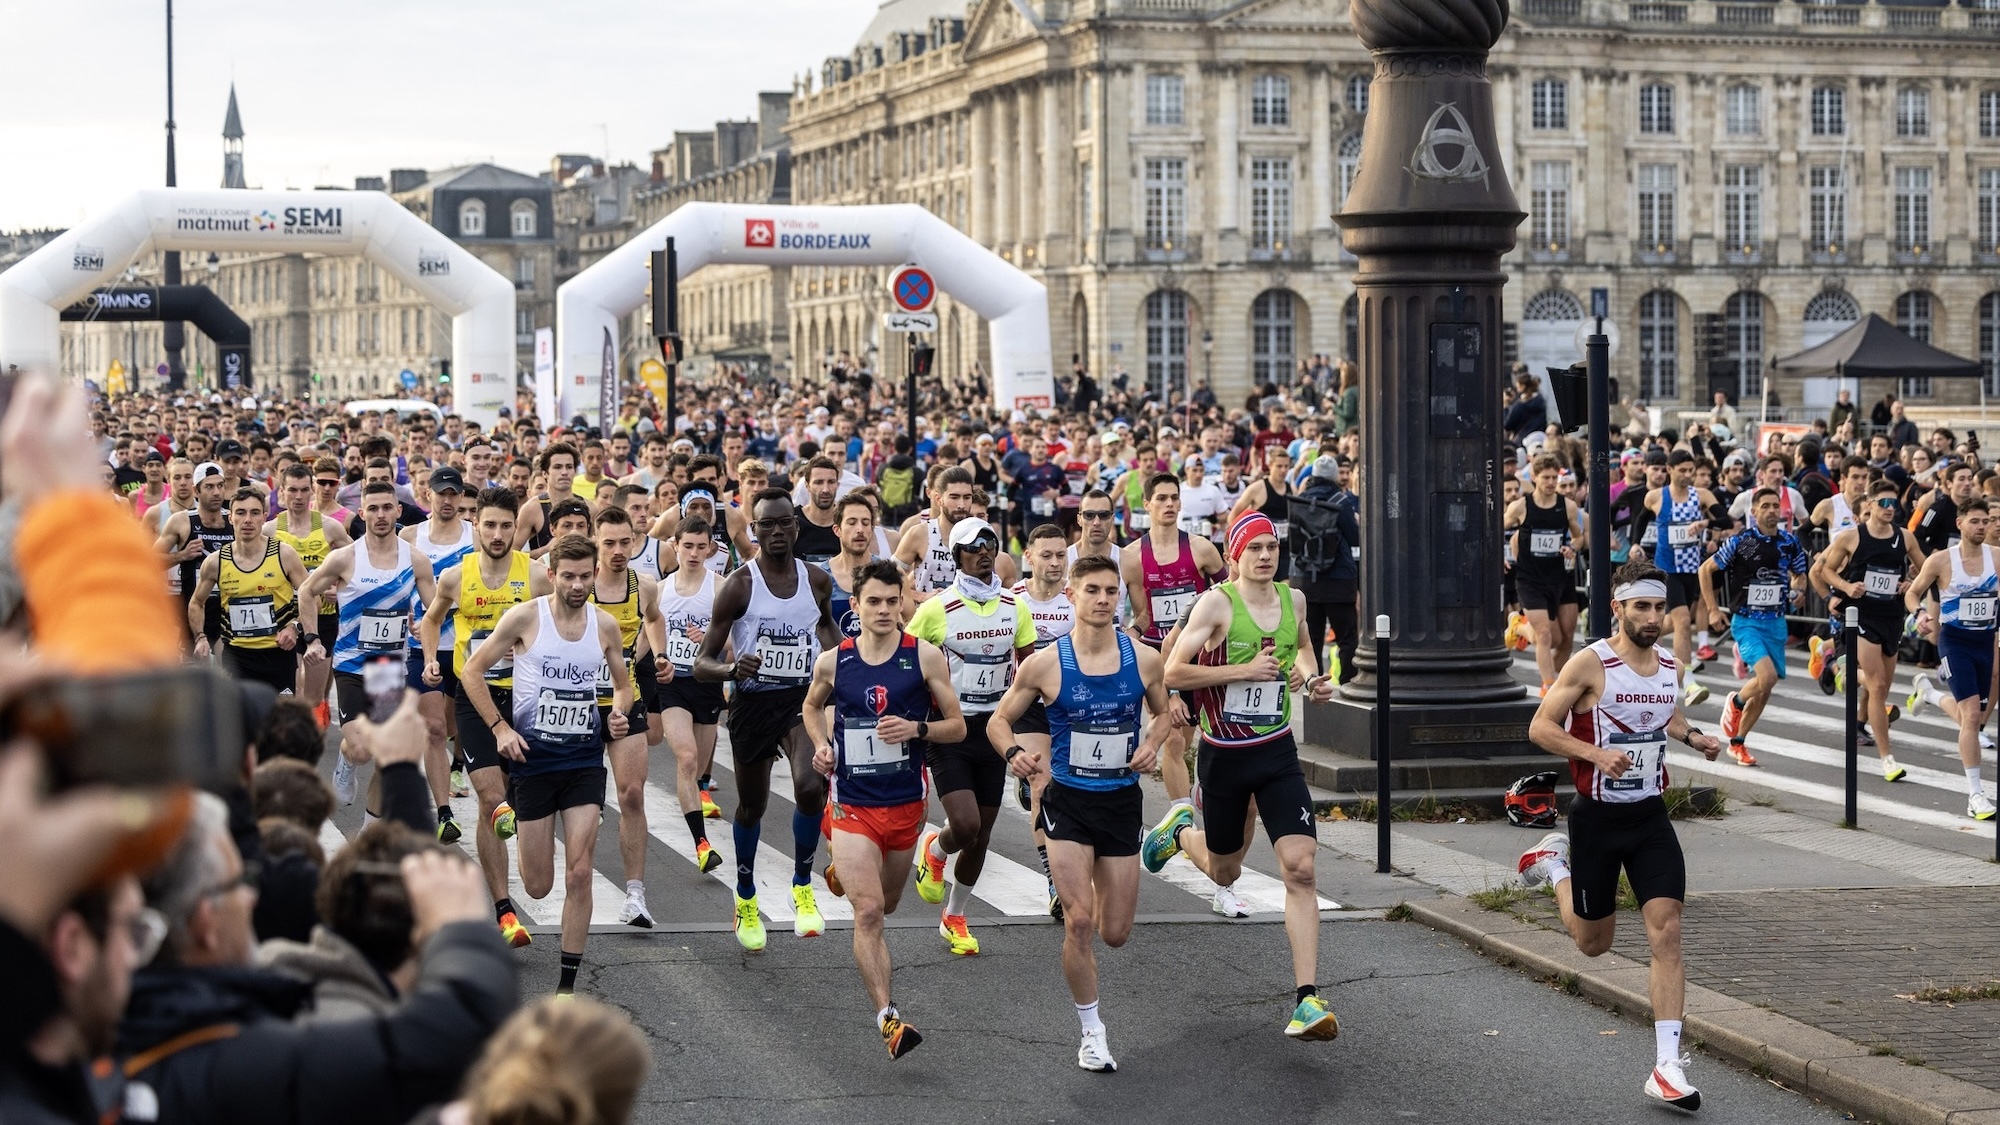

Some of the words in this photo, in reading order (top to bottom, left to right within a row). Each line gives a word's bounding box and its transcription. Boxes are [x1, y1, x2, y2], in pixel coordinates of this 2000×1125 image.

[284, 207, 342, 226] SEMI
[178, 217, 250, 231] matmut
[781, 219, 803, 229] Ville
[807, 221, 820, 229] de
[780, 234, 870, 249] BORDEAUX
[73, 256, 104, 267] SEMI
[419, 261, 450, 273] SEMI
[1537, 537, 1554, 549] 142
[1872, 576, 1890, 590] 190
[1755, 589, 1773, 601] 239
[1164, 600, 1179, 616] 21
[1968, 603, 1987, 615] 188
[240, 609, 255, 624] 71
[1031, 613, 1069, 621] RDEAUX
[374, 622, 389, 637] 16
[956, 627, 1014, 640] BORDEAUX
[977, 670, 995, 688] 41
[1245, 687, 1262, 708] 18
[1616, 694, 1675, 704] BORDEAUX
[539, 704, 587, 727] 15015
[866, 735, 873, 756] 1
[1092, 740, 1103, 761] 4
